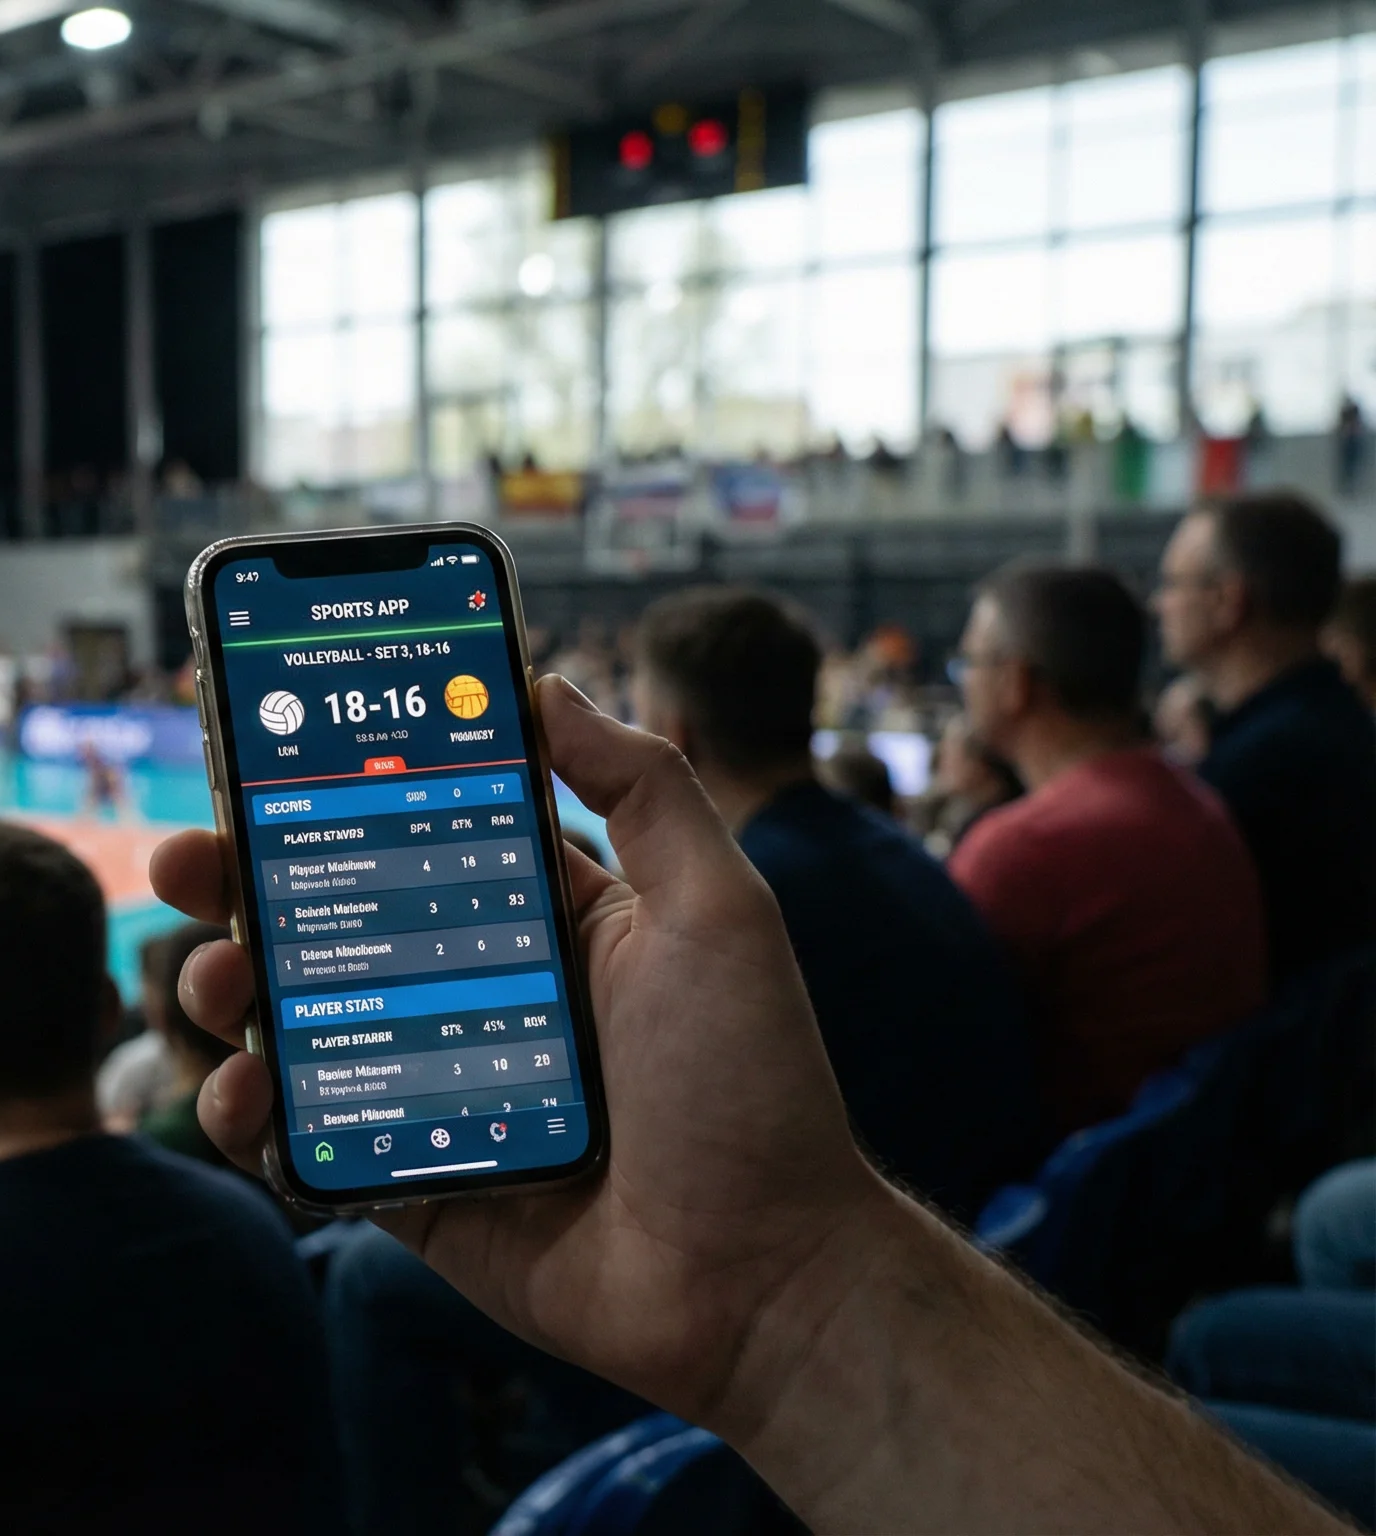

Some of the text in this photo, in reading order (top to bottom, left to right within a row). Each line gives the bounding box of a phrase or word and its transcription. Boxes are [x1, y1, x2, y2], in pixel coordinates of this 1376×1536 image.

[310, 598, 410, 621] SPORTS APP
[283, 648, 365, 667] VOLLEYBALL
[374, 645, 399, 660] SET
[400, 644, 414, 660] 3,
[415, 641, 451, 657] 18-16
[324, 684, 427, 725] 18-16
[284, 831, 322, 845] PLAYER
[429, 901, 438, 914] 3
[435, 943, 445, 956] 2
[477, 939, 486, 951] 6
[294, 997, 385, 1018] PLAYER STATS
[311, 1035, 351, 1050] PLAYER
[492, 1058, 508, 1071] 10
